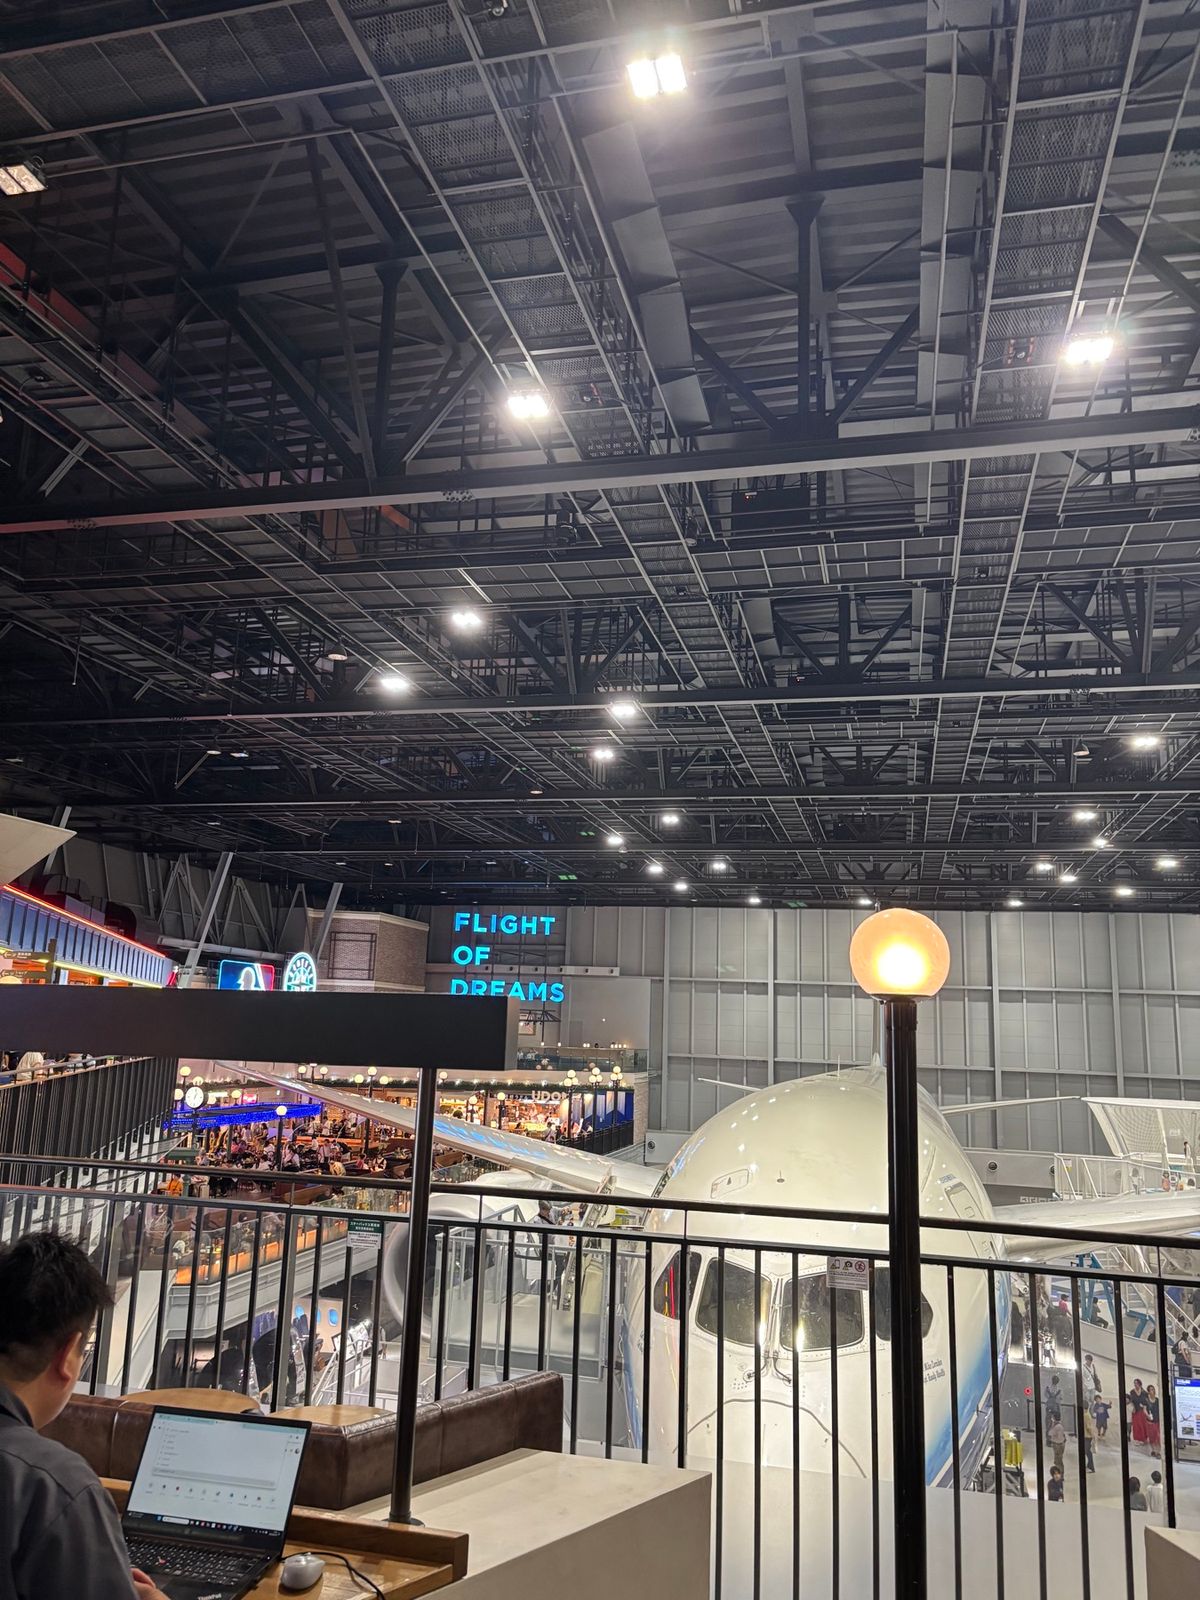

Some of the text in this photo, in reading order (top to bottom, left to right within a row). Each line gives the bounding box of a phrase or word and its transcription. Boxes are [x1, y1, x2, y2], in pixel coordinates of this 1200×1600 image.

[454, 912, 556, 935] FLIGHT
[453, 945, 491, 966] OF
[450, 979, 565, 1003] DREAMS
